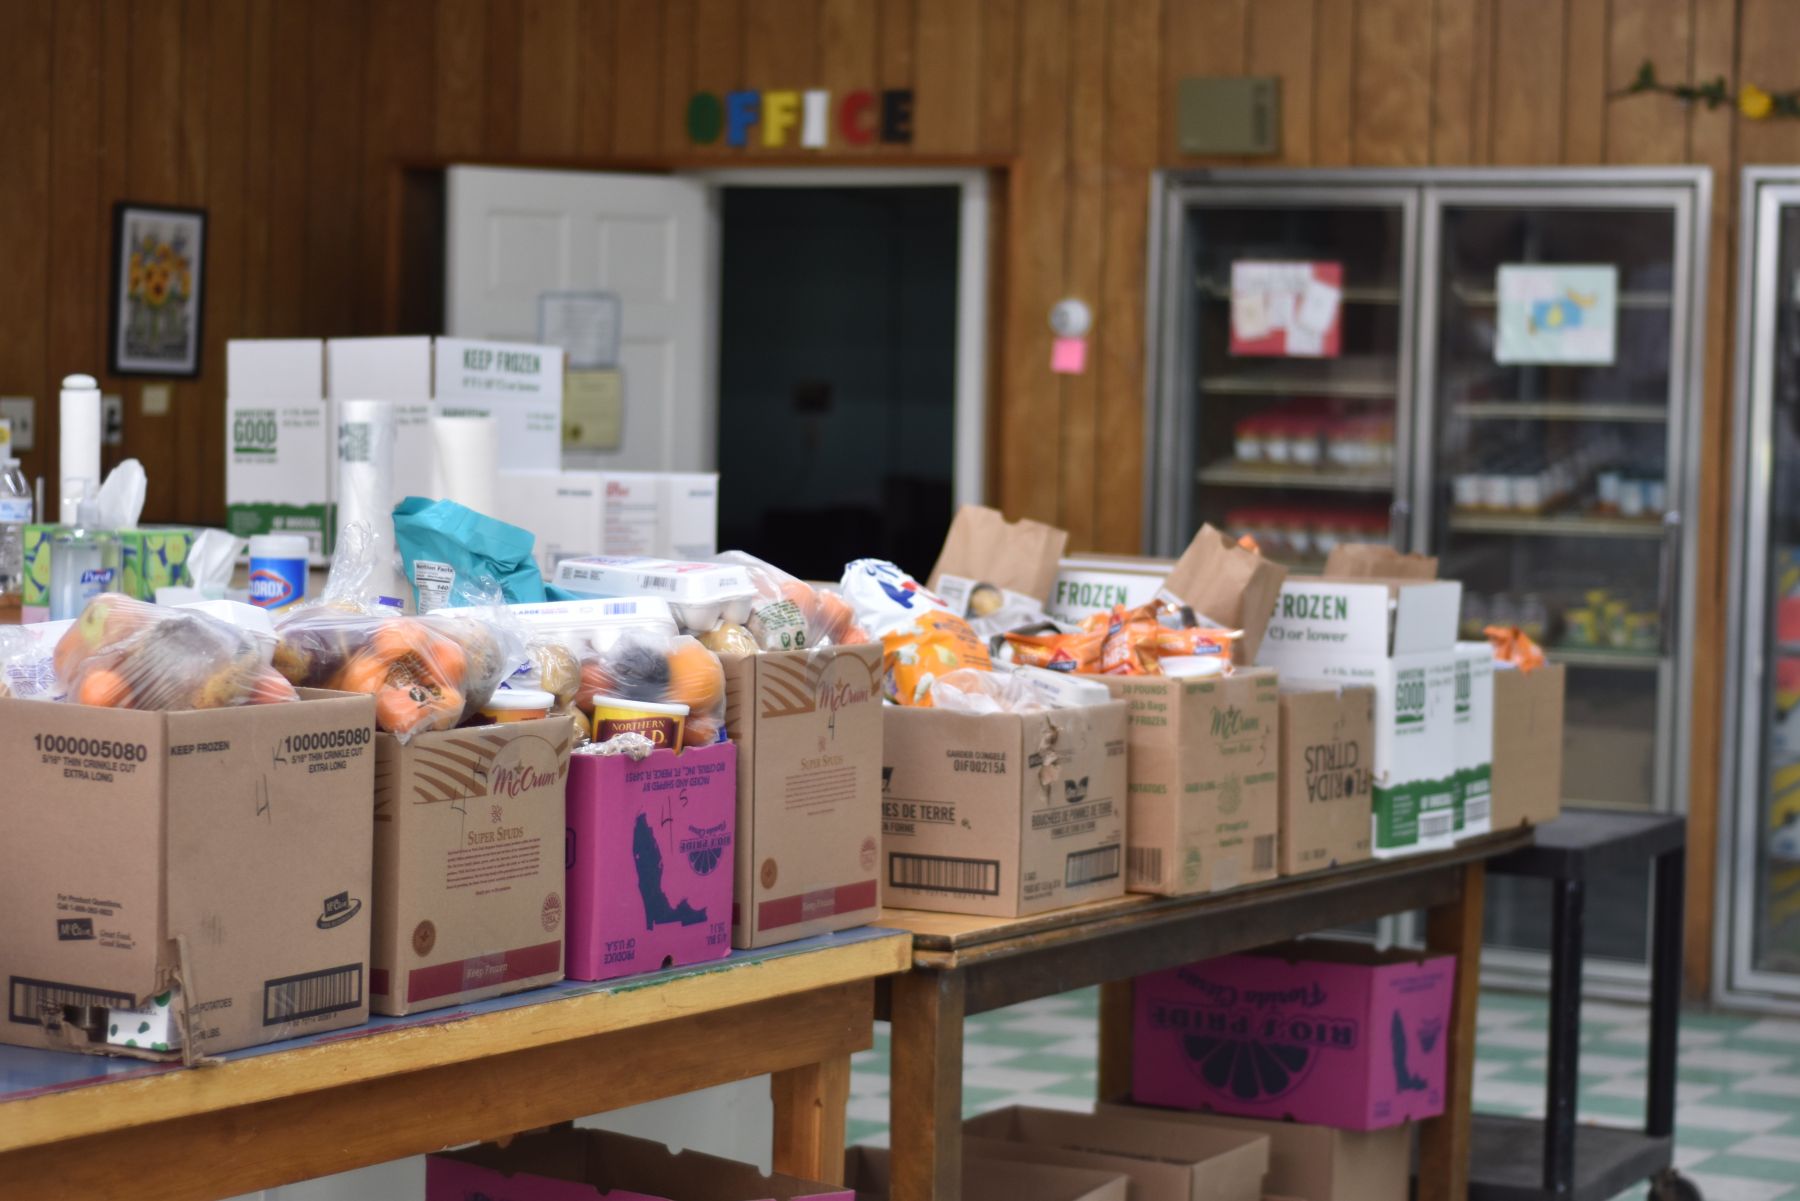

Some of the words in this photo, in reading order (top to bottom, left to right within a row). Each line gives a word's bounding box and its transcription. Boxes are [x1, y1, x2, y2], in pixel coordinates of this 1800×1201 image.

[687, 89, 913, 148] OFFICE
[464, 350, 492, 371] KEEP
[497, 351, 541, 375] FROZEN
[234, 418, 278, 445] GOOD
[1057, 580, 1128, 609] FROZEN
[612, 720, 665, 732] NORTHERN
[34, 733, 148, 763] 1000005080
[170, 744, 194, 757] KEEP
[196, 740, 231, 754] FROZEN
[285, 727, 371, 753] 1000005080
[63, 755, 82, 768] THIN
[83, 758, 119, 772] CRINKLE
[120, 762, 137, 774] CUT
[308, 751, 323, 763] THIN
[323, 748, 350, 761] CRINKLE
[350, 746, 364, 757] CUT
[1305, 740, 1359, 775] CITRUS
[63, 768, 90, 780] EXTRA
[91, 772, 114, 784] LONG
[308, 762, 329, 774] EXTRA
[329, 760, 347, 772] LONG
[492, 764, 557, 800] McCrum
[901, 803, 917, 819] DE
[920, 804, 956, 822] TERRE
[467, 831, 495, 847] SUPER
[496, 826, 524, 842] SPUDS
[625, 937, 636, 949] OF
[604, 950, 635, 965] PRODUCE
